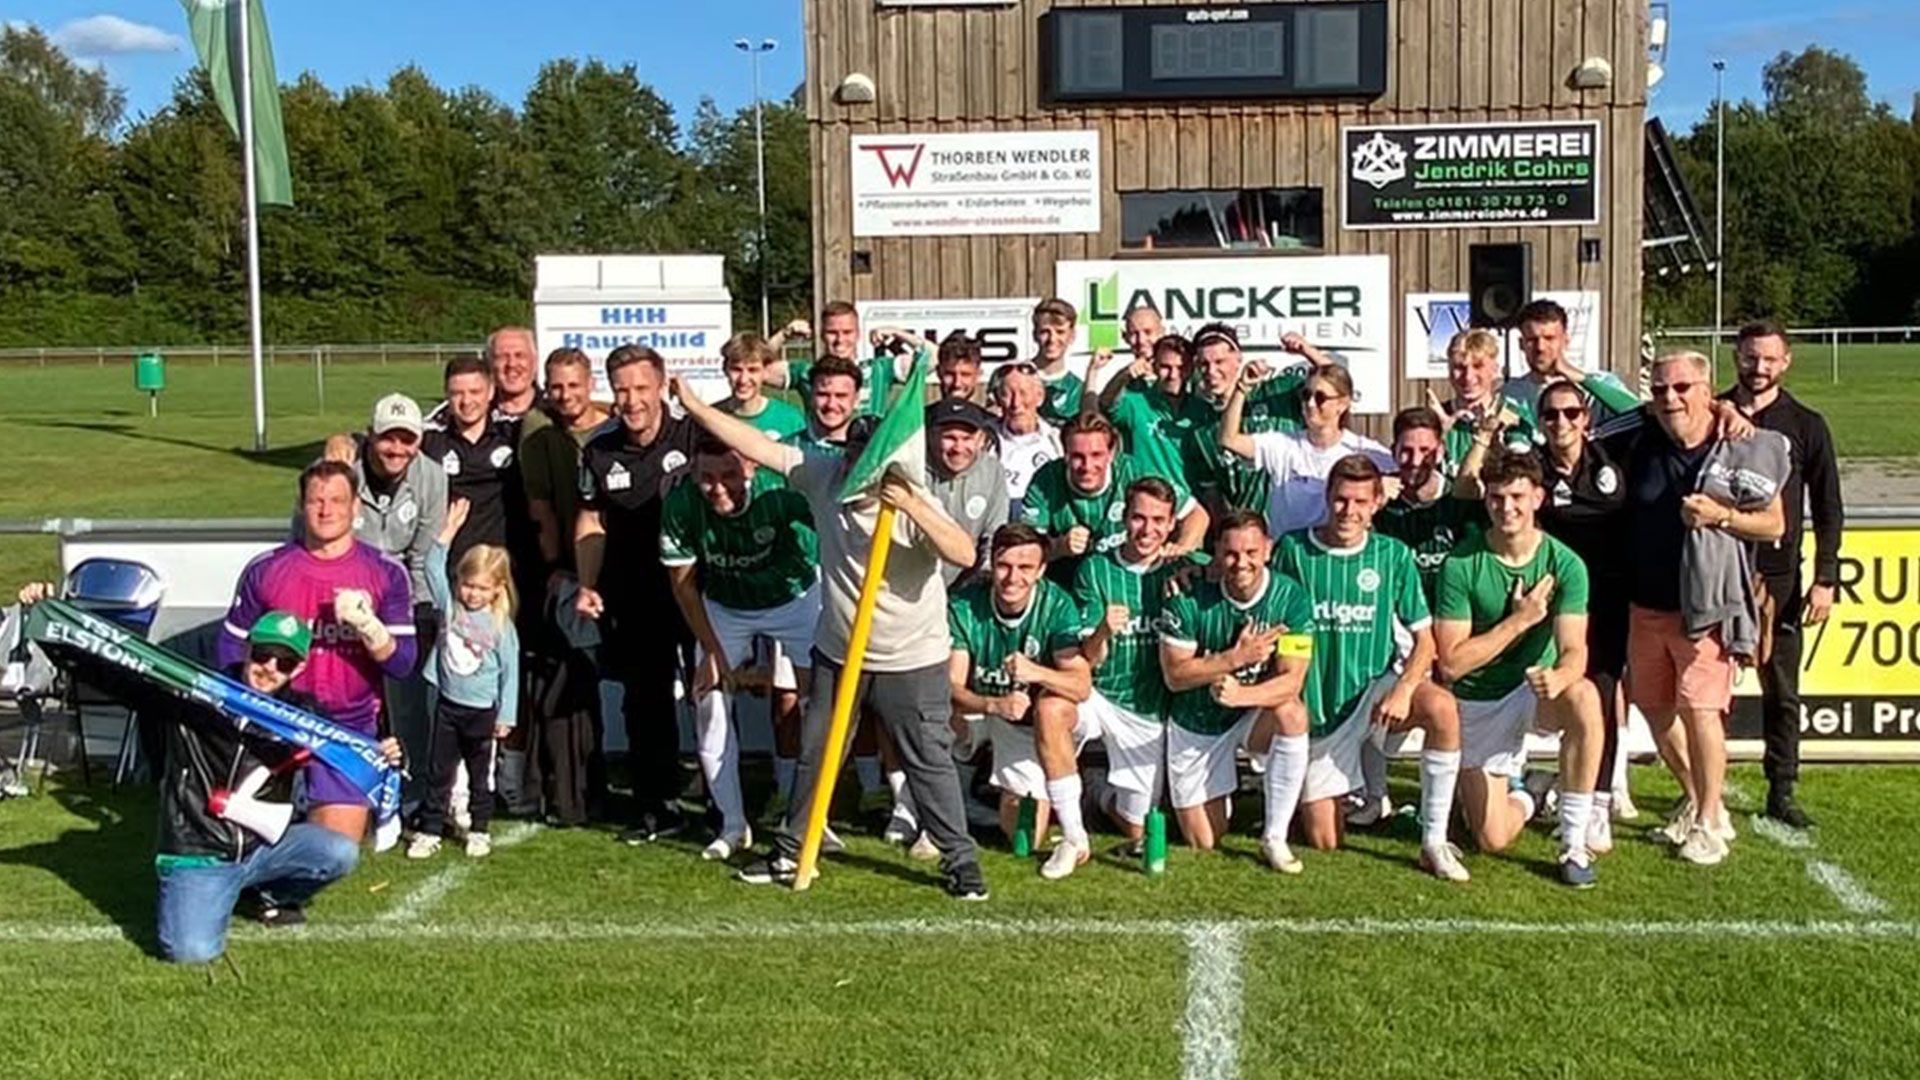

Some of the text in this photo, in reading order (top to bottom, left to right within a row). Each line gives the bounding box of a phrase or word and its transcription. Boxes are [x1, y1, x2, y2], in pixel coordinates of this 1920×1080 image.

[931, 149, 1090, 165] THORBEN WENDLER
[1414, 133, 1590, 160] ZIMMEREI
[1001, 170, 1037, 181] GmbH
[1414, 159, 1589, 180] Jendrik Cohrs
[1089, 283, 1361, 320] LANCKER
[601, 308, 667, 324] HHH
[563, 331, 706, 349] Hauschild
[1834, 557, 1920, 605] RU
[81, 613, 131, 644] TSV
[46, 622, 156, 673] ELSTORF
[1873, 702, 1920, 735] Pr
